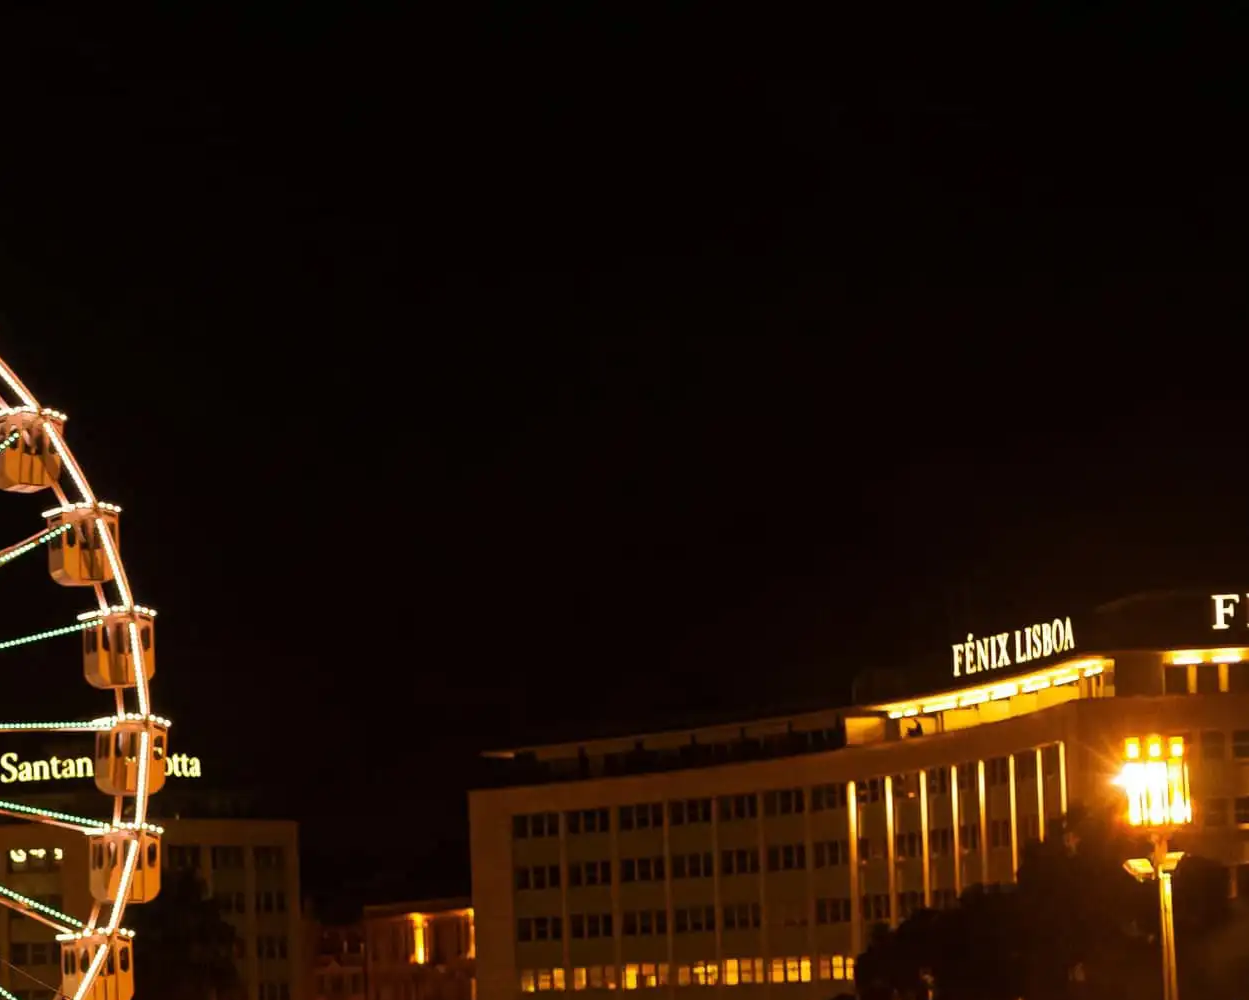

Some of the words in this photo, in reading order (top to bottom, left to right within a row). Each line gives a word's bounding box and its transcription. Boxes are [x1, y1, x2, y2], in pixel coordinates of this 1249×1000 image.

[1210, 593, 1249, 630] F
[952, 632, 1011, 677] FÉNIX
[1014, 615, 1075, 664] LISBOA
[0, 752, 94, 783] Santan
[152, 746, 201, 777] otta
